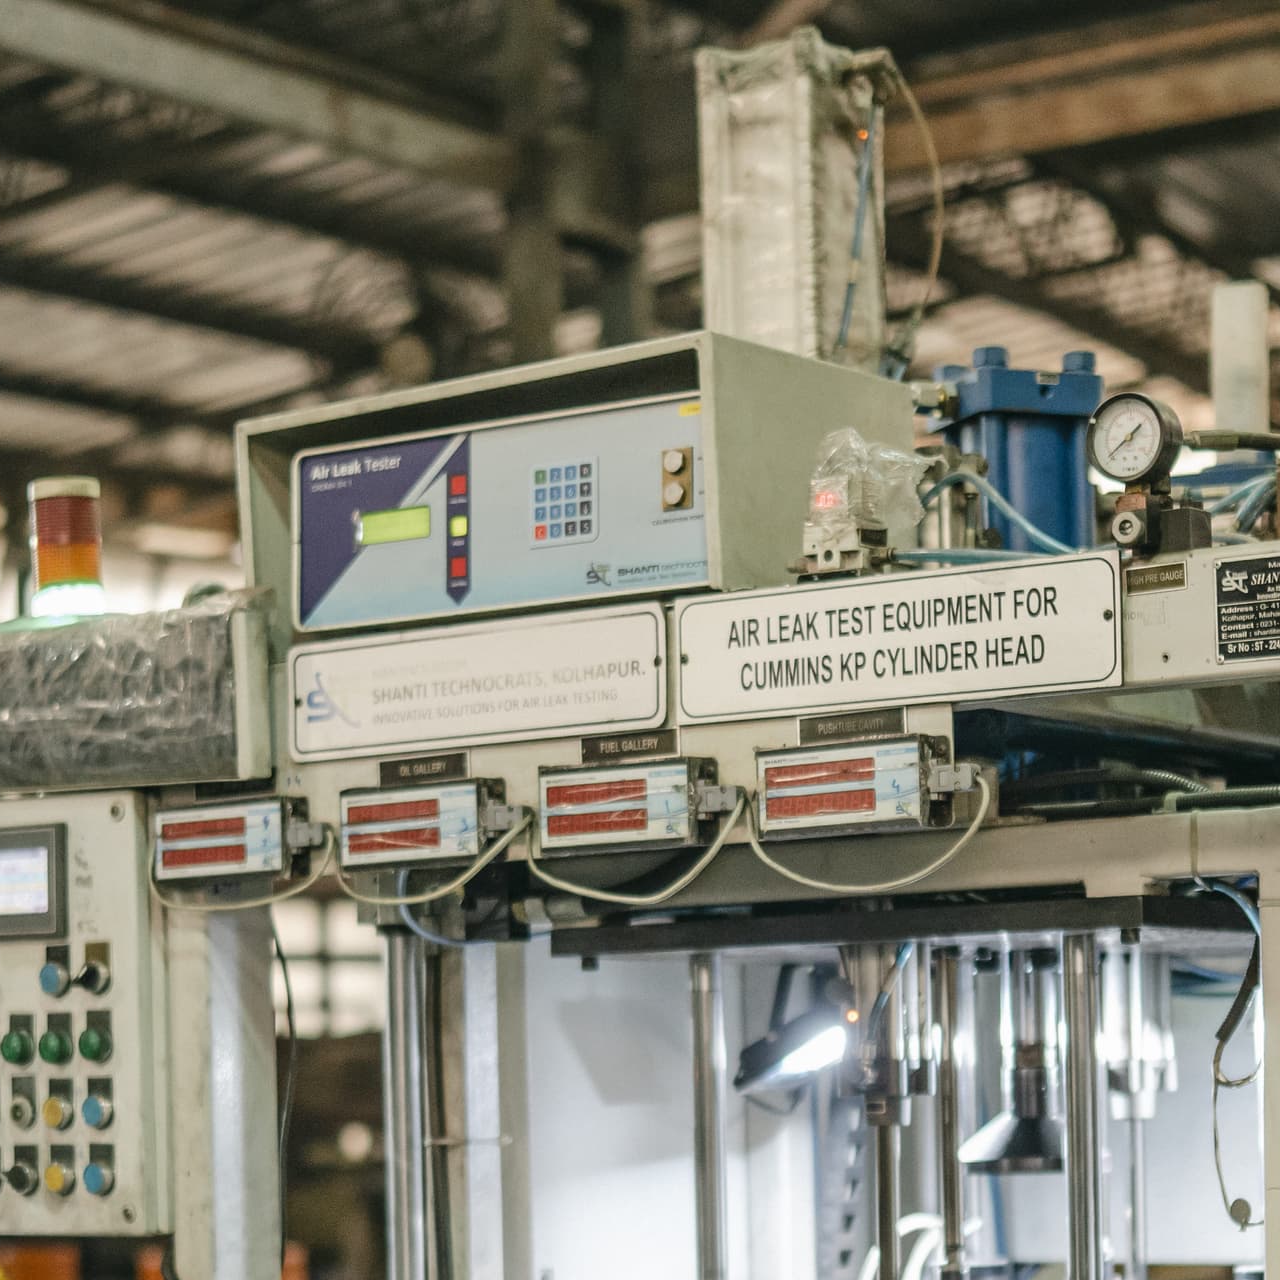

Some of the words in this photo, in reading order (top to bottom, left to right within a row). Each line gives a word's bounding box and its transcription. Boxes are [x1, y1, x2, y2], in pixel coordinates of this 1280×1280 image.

[311, 464, 330, 481] Air
[333, 458, 362, 478] Leak
[364, 456, 401, 473] Tester
[1160, 570, 1184, 582] GAUGE
[728, 618, 760, 649] AIR
[767, 612, 819, 645] LEAK
[825, 606, 875, 639] TEST
[883, 591, 1006, 633] EQUIPMENT
[1013, 586, 1058, 620] FOR
[741, 655, 833, 691] CUMMINS
[840, 651, 867, 682] KP
[873, 641, 979, 678] CYLINDER
[986, 634, 1046, 668] HEAD
[372, 684, 428, 704] SHANTI
[600, 741, 621, 753] FUEL
[621, 736, 659, 752] GALLERY
